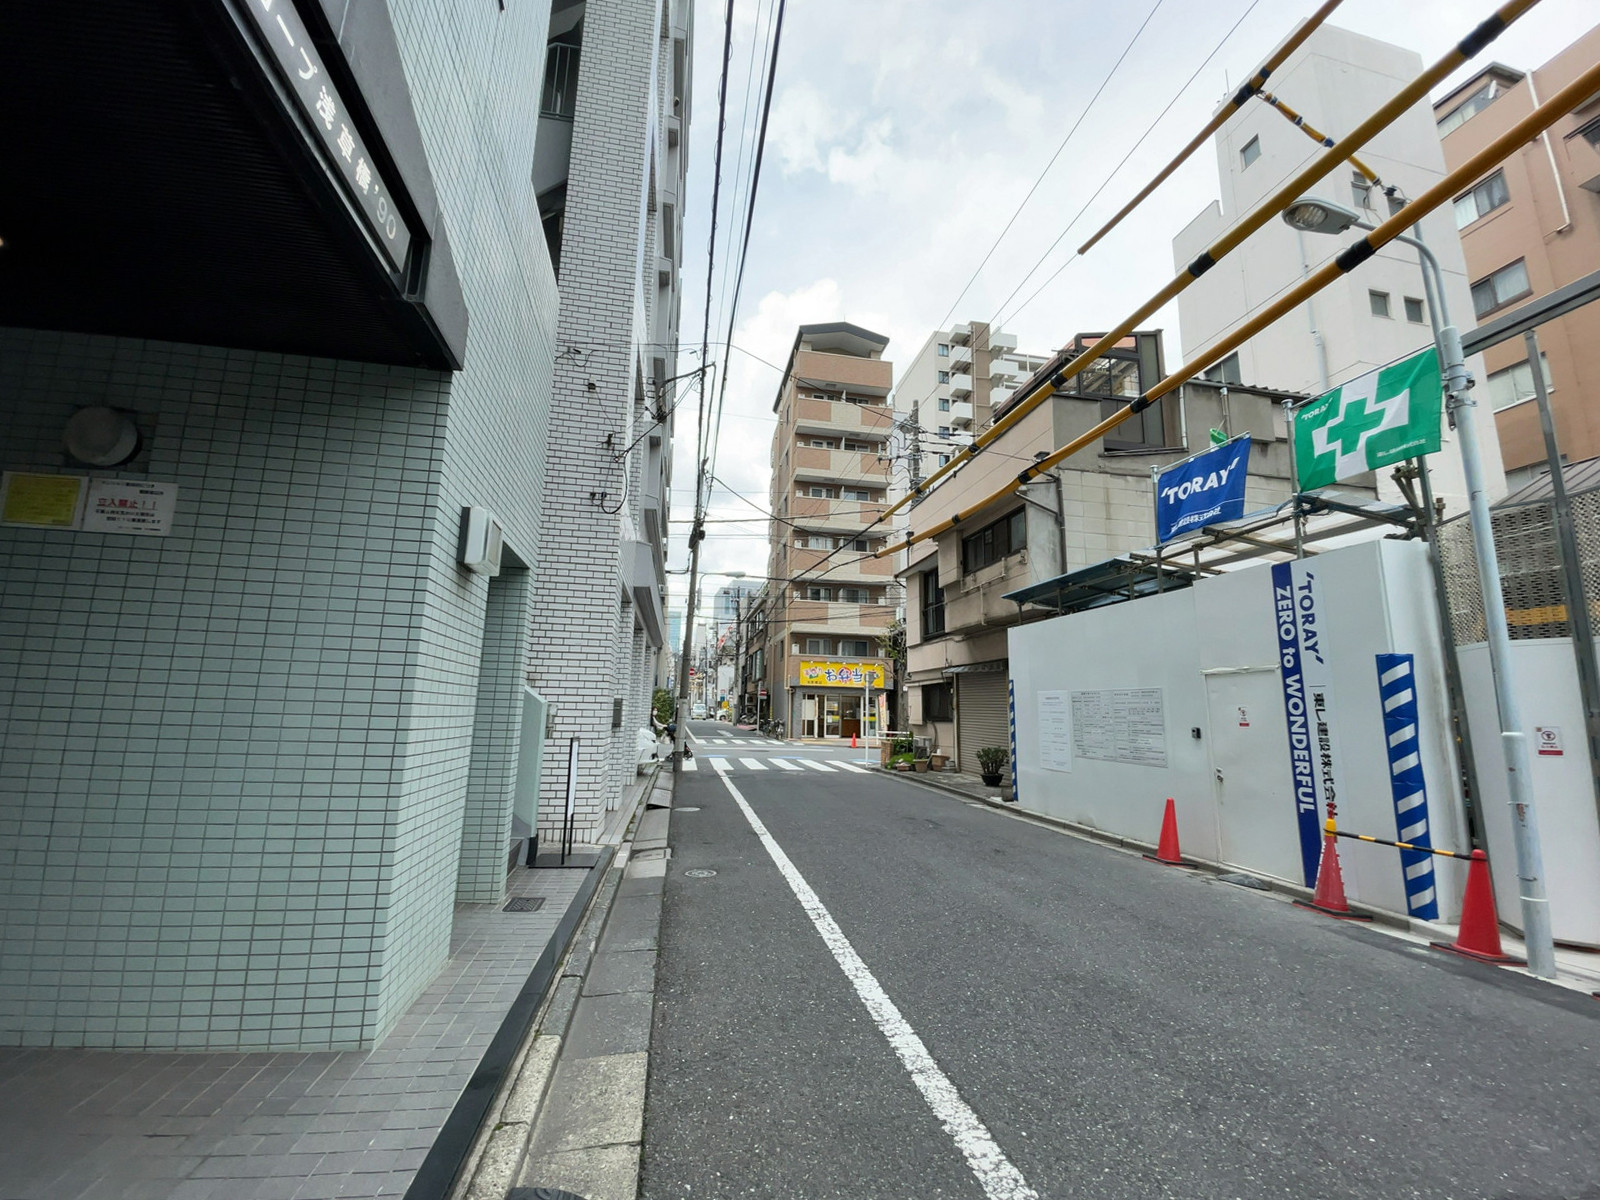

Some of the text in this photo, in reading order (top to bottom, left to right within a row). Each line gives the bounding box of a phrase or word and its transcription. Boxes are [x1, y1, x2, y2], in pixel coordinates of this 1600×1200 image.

[824, 667, 863, 683] お弁当
[1276, 585, 1315, 814] ZERO to WONDERFUL
